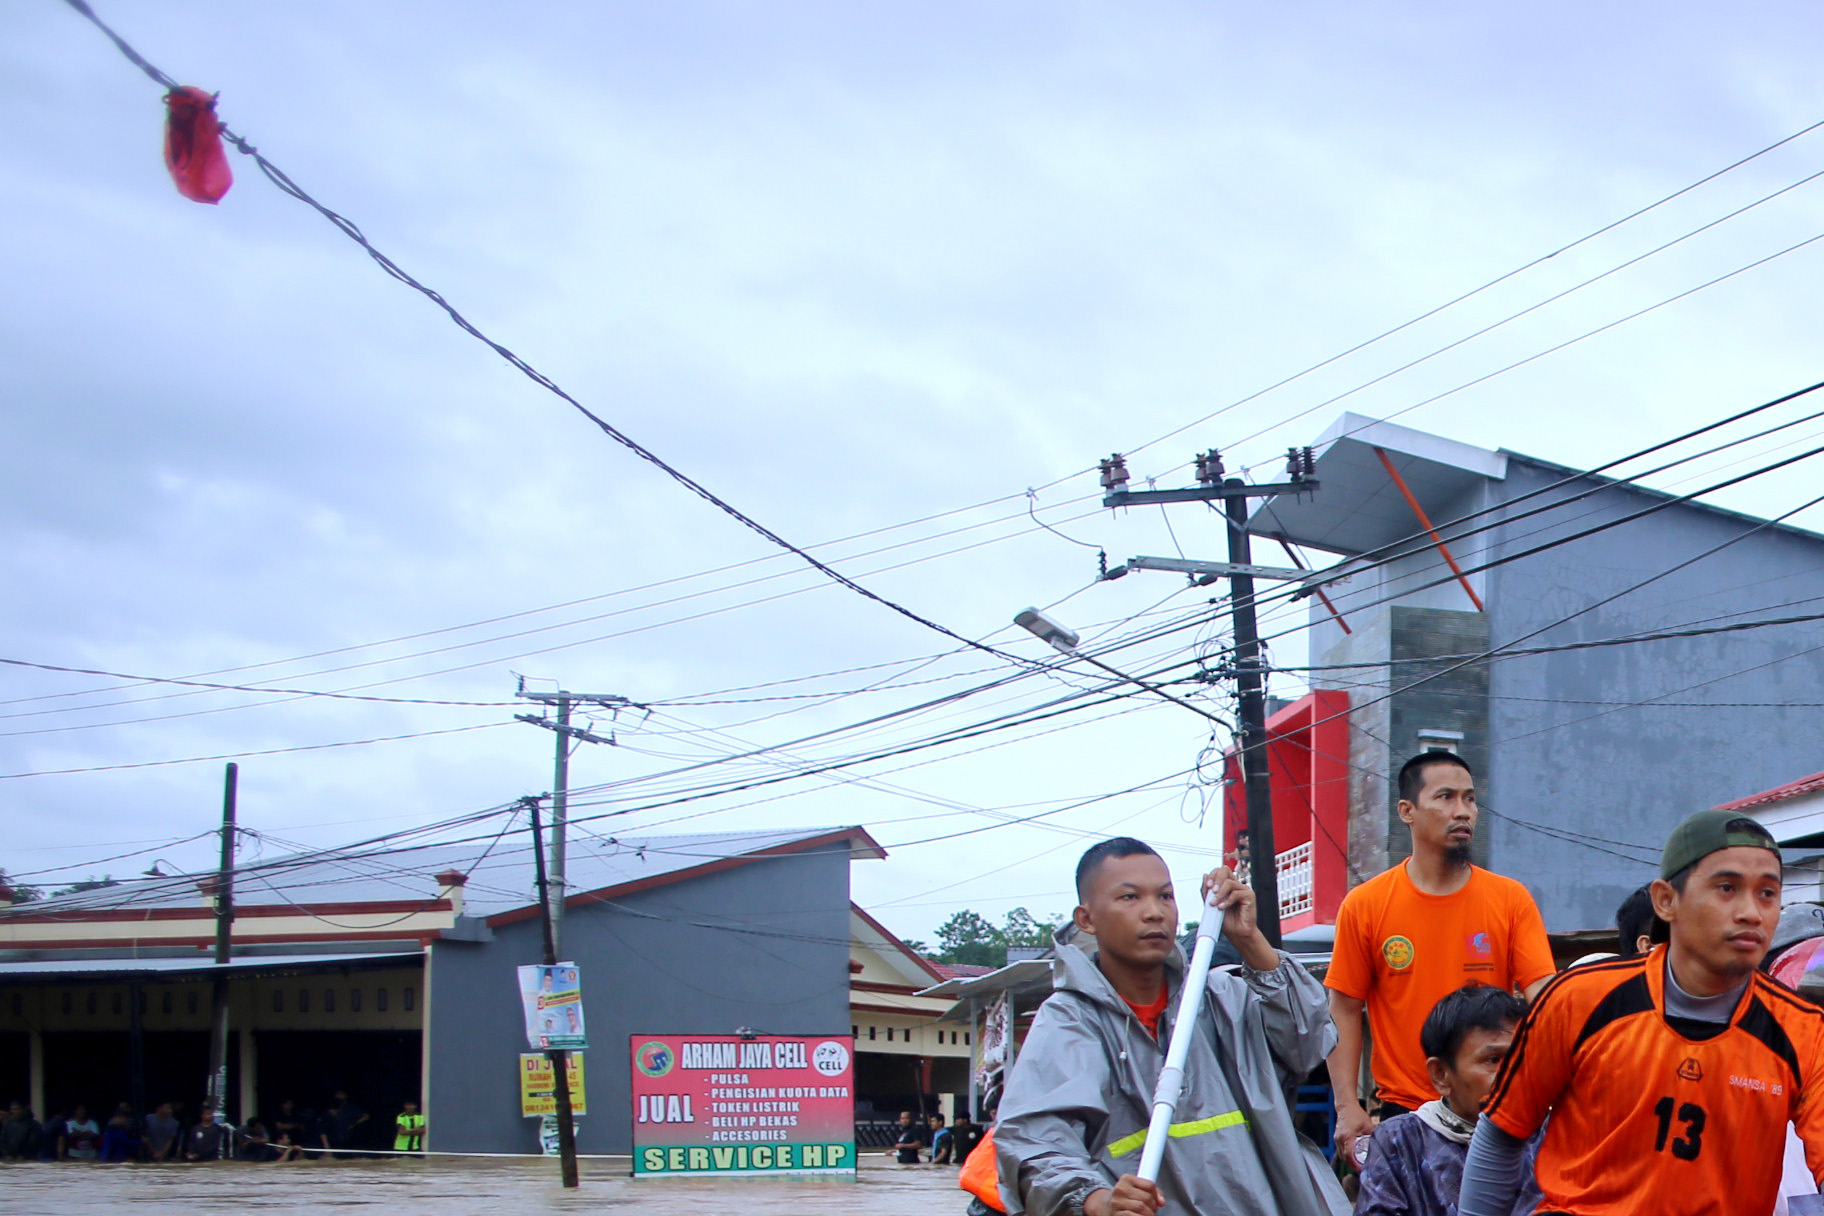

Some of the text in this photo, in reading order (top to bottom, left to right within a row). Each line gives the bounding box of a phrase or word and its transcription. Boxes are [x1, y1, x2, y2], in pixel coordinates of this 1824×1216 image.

[681, 1042, 808, 1069] ARHAM JAYA CELL
[527, 1057, 577, 1071] DI JAL
[818, 1061, 843, 1071] CELL
[711, 1074, 749, 1085] PULSA
[1728, 1074, 1766, 1092] SMANSA
[711, 1087, 848, 1098] PENGISIAN KUOTA DATA
[638, 1094, 695, 1123] JUAL
[711, 1102, 800, 1113] TOKEN LISTRIK
[712, 1115, 797, 1127] BELI HP BEKAS
[712, 1130, 787, 1141] ACCESORIES
[1654, 1096, 1706, 1162] 13
[643, 1144, 846, 1171] SERVICE HP
